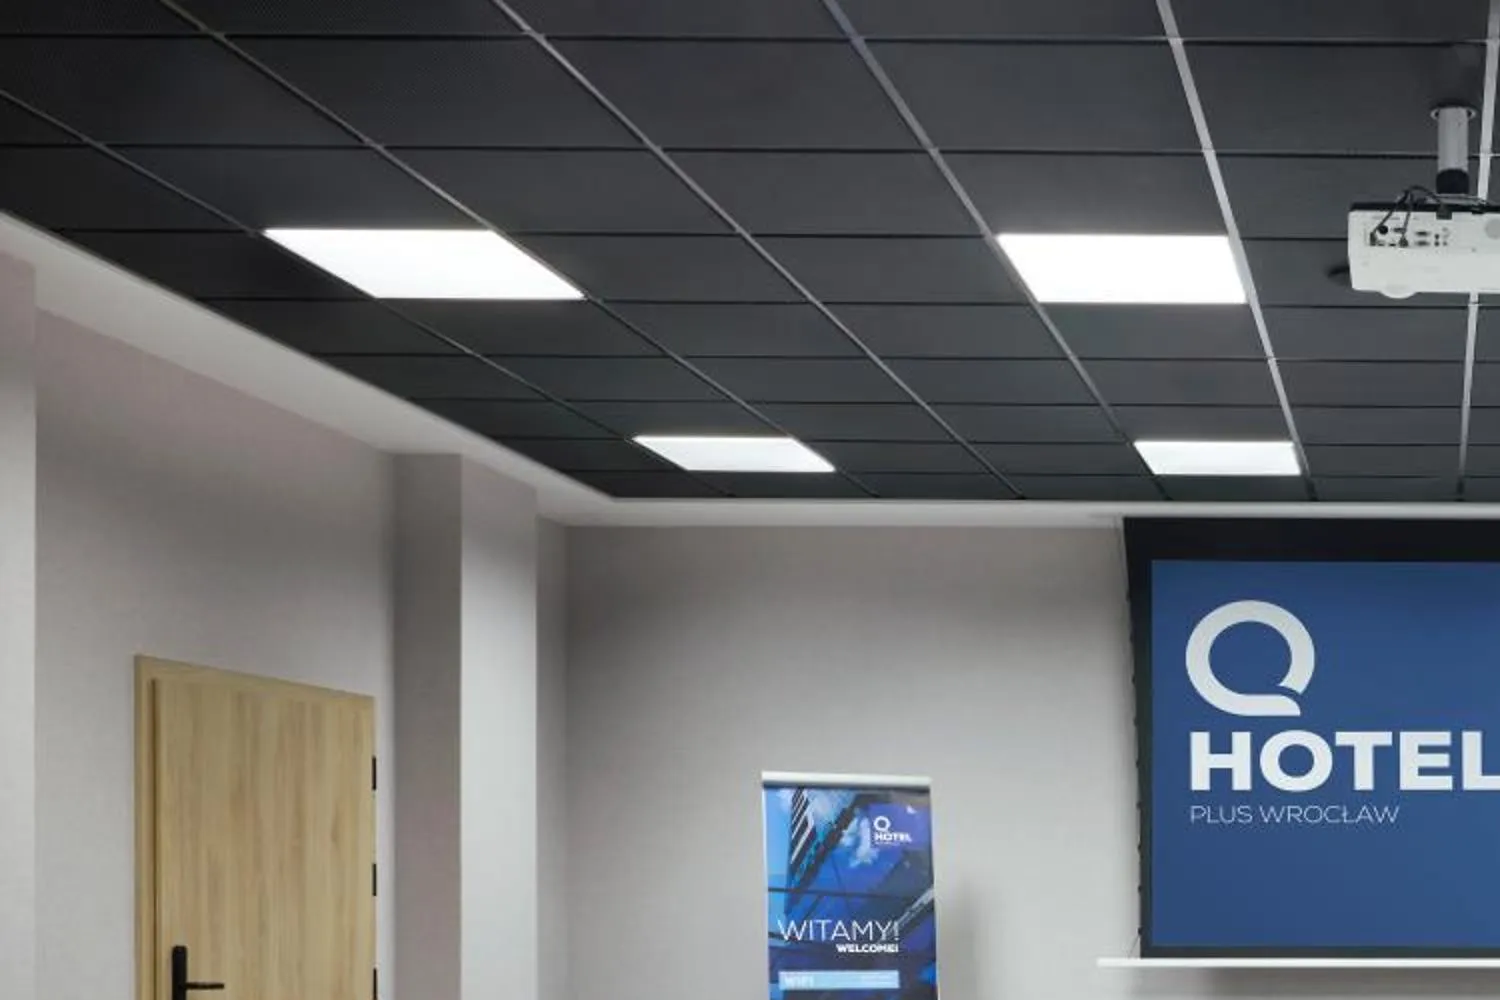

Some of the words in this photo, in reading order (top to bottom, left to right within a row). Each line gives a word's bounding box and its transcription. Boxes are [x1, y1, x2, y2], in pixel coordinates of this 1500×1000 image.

[1185, 599, 1316, 717] Q
[1190, 804, 1253, 825] PLUS
[1258, 804, 1401, 825] WROCŁAW
[777, 918, 900, 942] WITAMY!
[835, 942, 900, 954] WELCOME!
